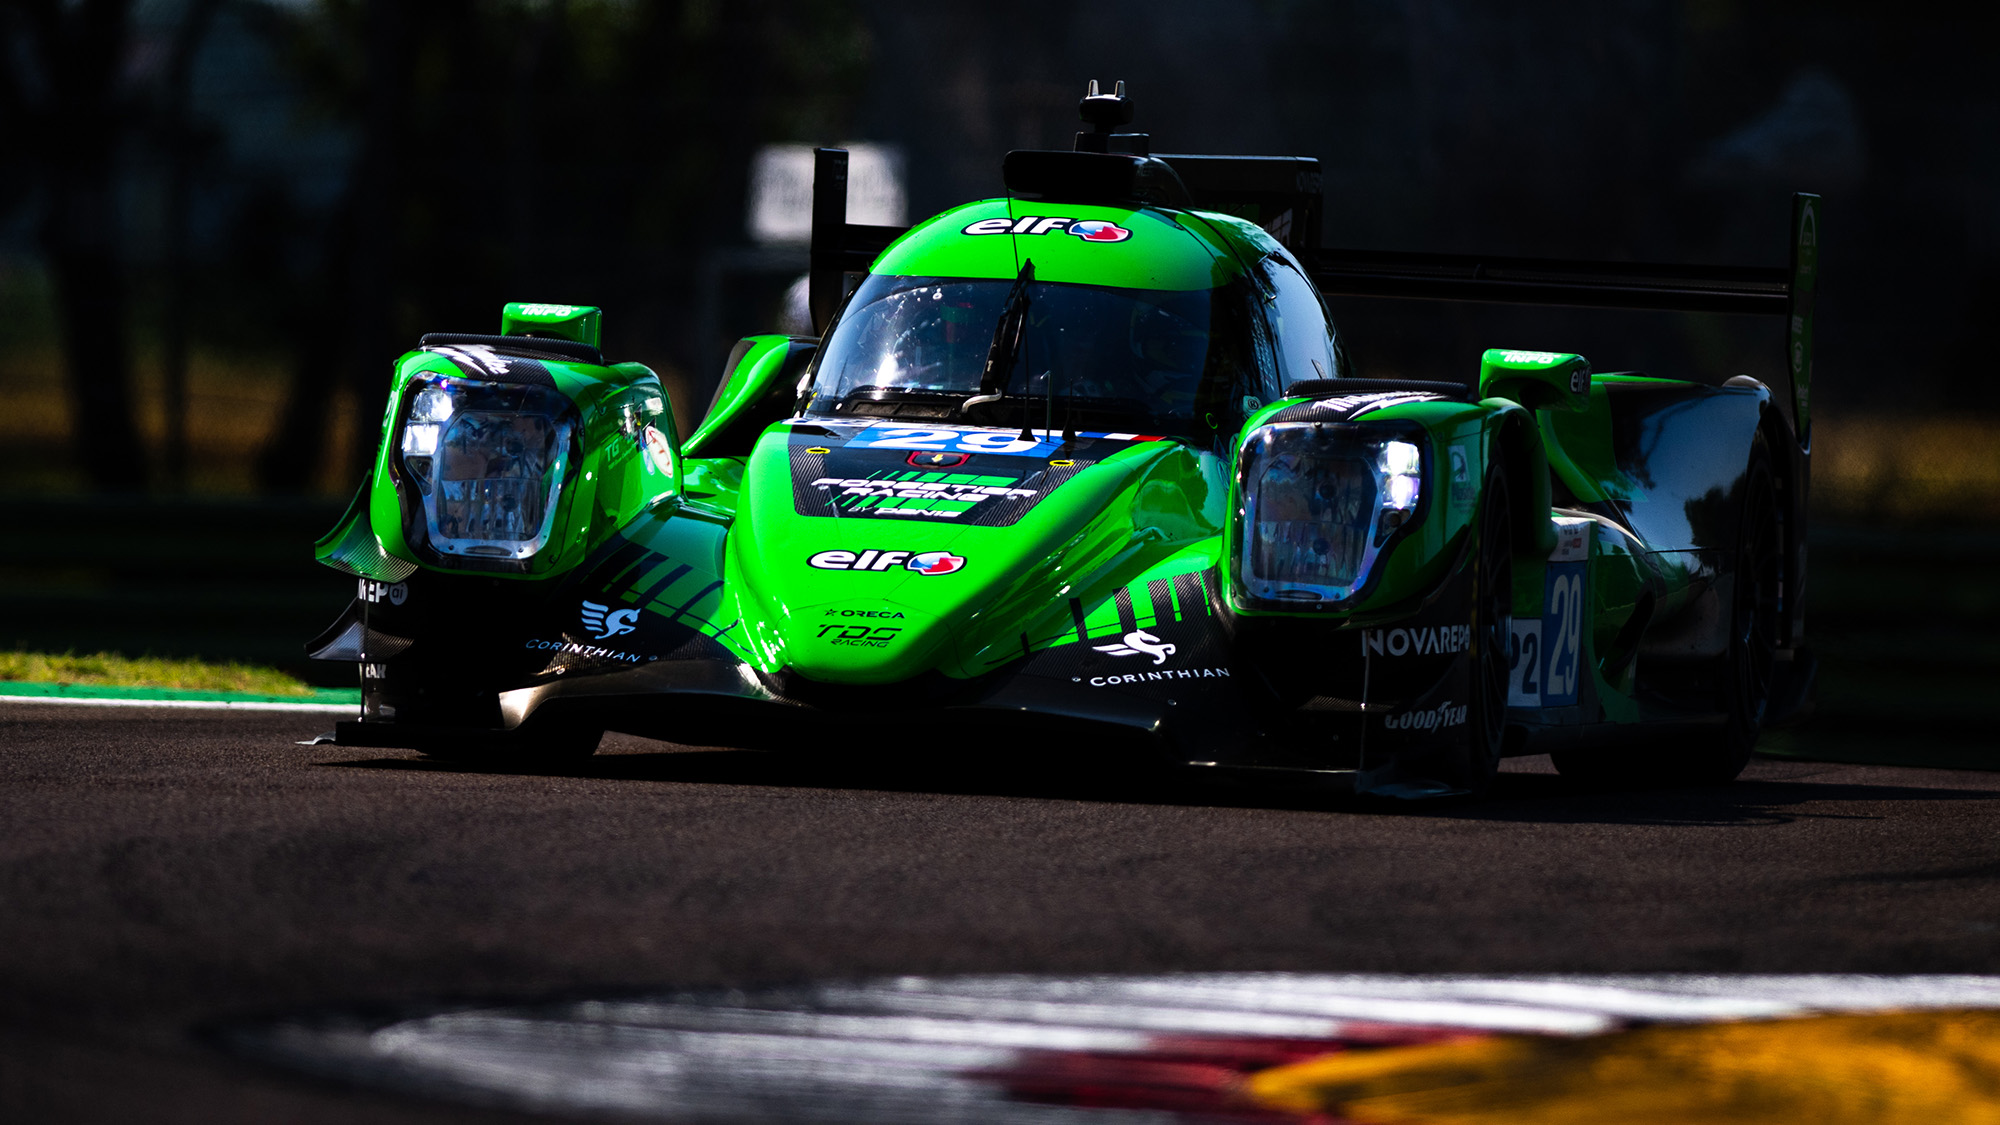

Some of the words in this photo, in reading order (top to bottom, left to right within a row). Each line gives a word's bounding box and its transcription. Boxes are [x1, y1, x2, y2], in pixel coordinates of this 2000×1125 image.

[963, 216, 1072, 234] elf
[868, 429, 1042, 453] 29
[811, 478, 1037, 498] FORESTIER
[842, 487, 990, 502] RACING
[874, 507, 963, 518] DENIS
[809, 549, 910, 571] elf
[841, 609, 905, 619] ORECA
[816, 624, 903, 641] TDS
[1547, 573, 1581, 696] 29
[525, 638, 641, 662] CORINTHIAN
[830, 638, 890, 648] RACING
[1089, 667, 1231, 687] CORINTHIAN
